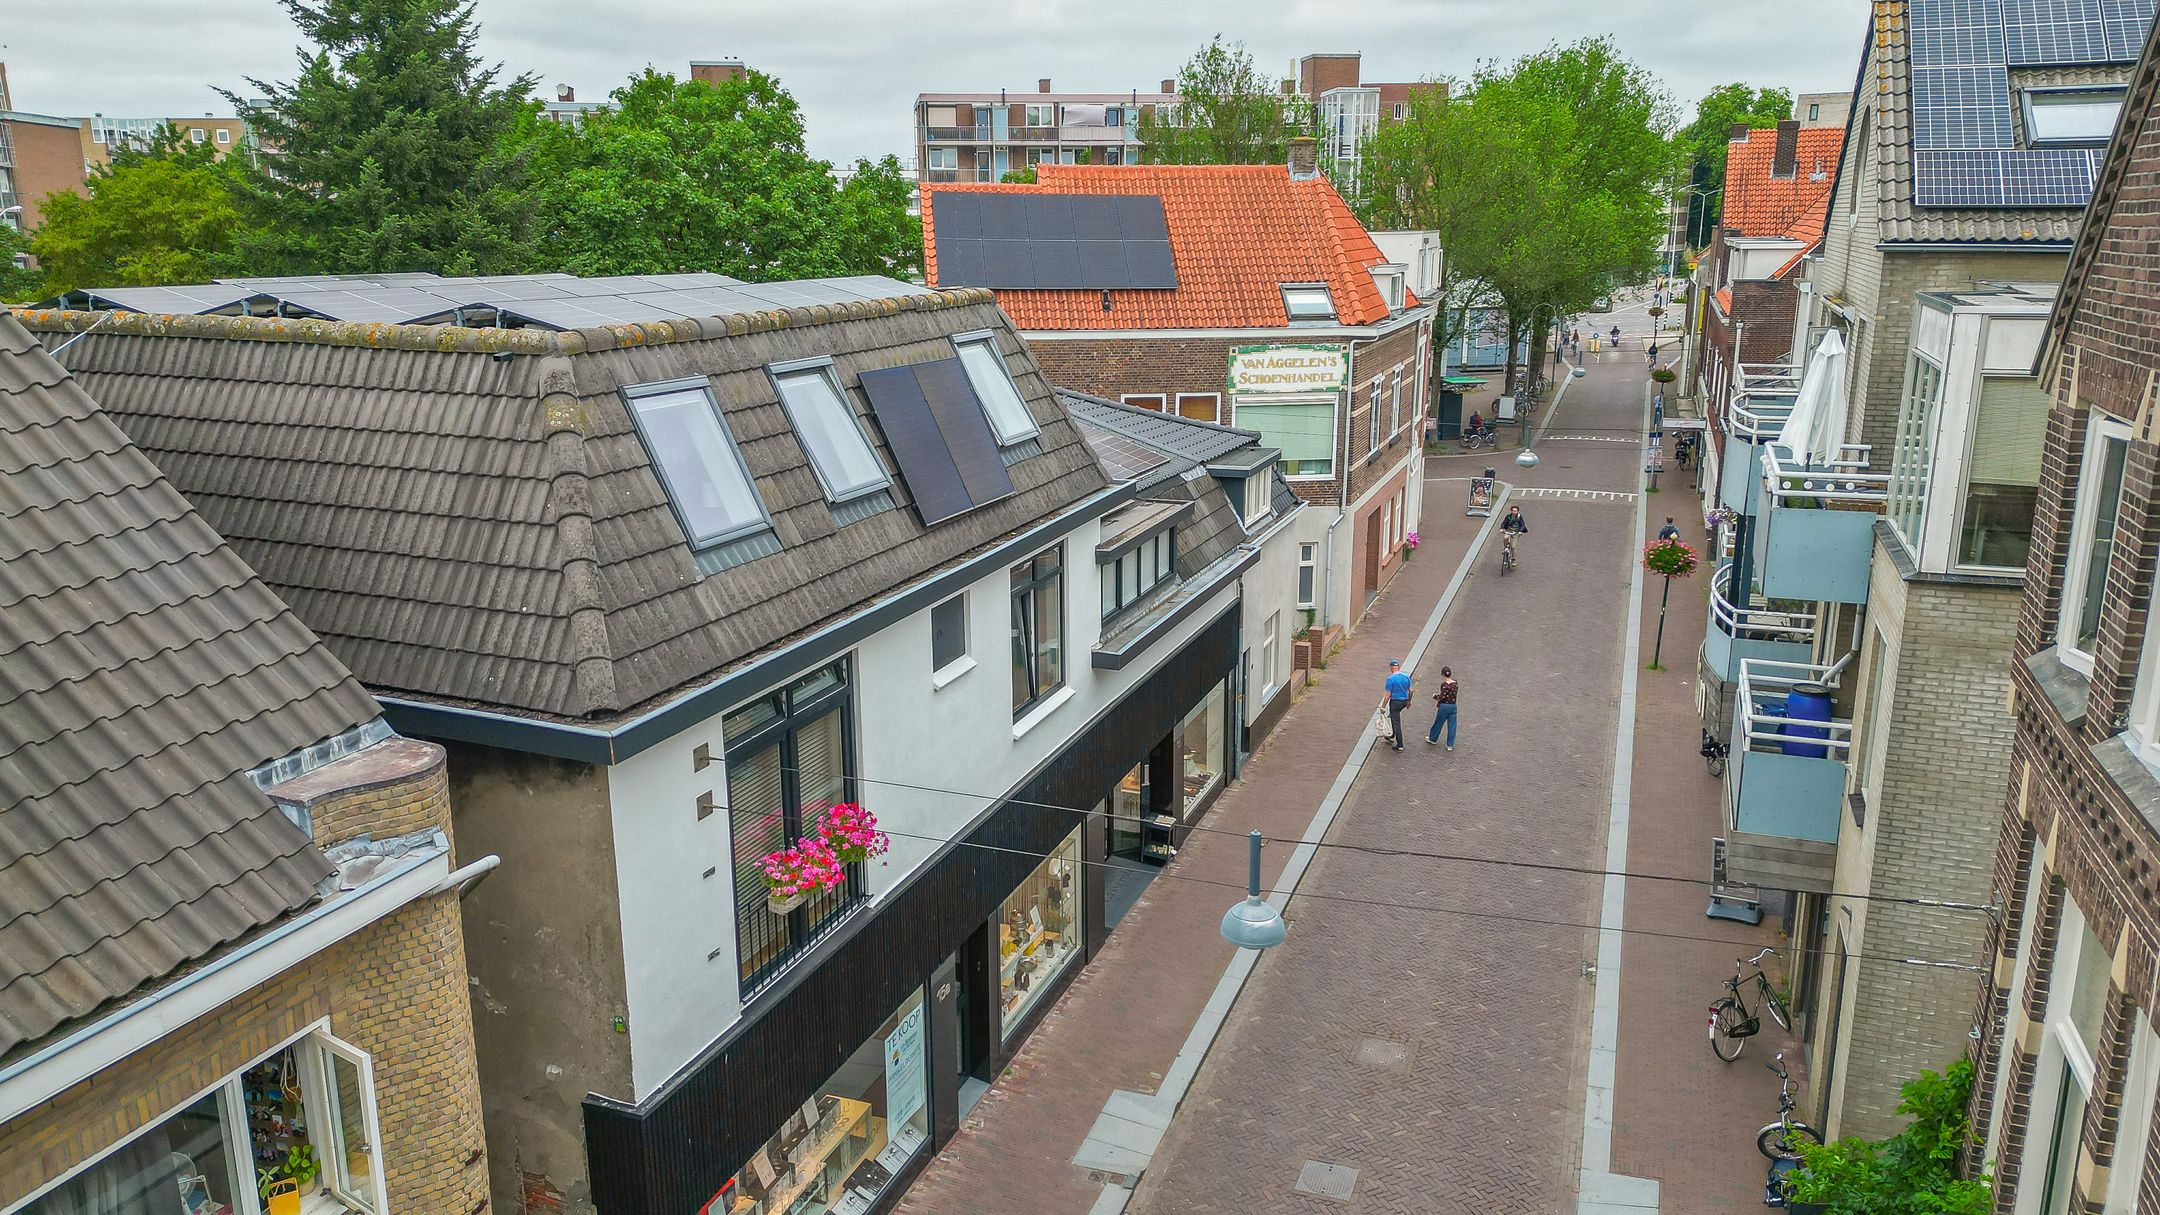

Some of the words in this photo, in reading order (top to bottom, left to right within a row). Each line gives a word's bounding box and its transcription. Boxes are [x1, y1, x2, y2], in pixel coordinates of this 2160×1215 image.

[1240, 358, 1265, 370] VAN
[1266, 356, 1338, 369] AGGELEN'S
[1238, 371, 1338, 384] SCHOENHANDEL
[886, 1033, 897, 1051] TE
[898, 1009, 921, 1040] KOOP
